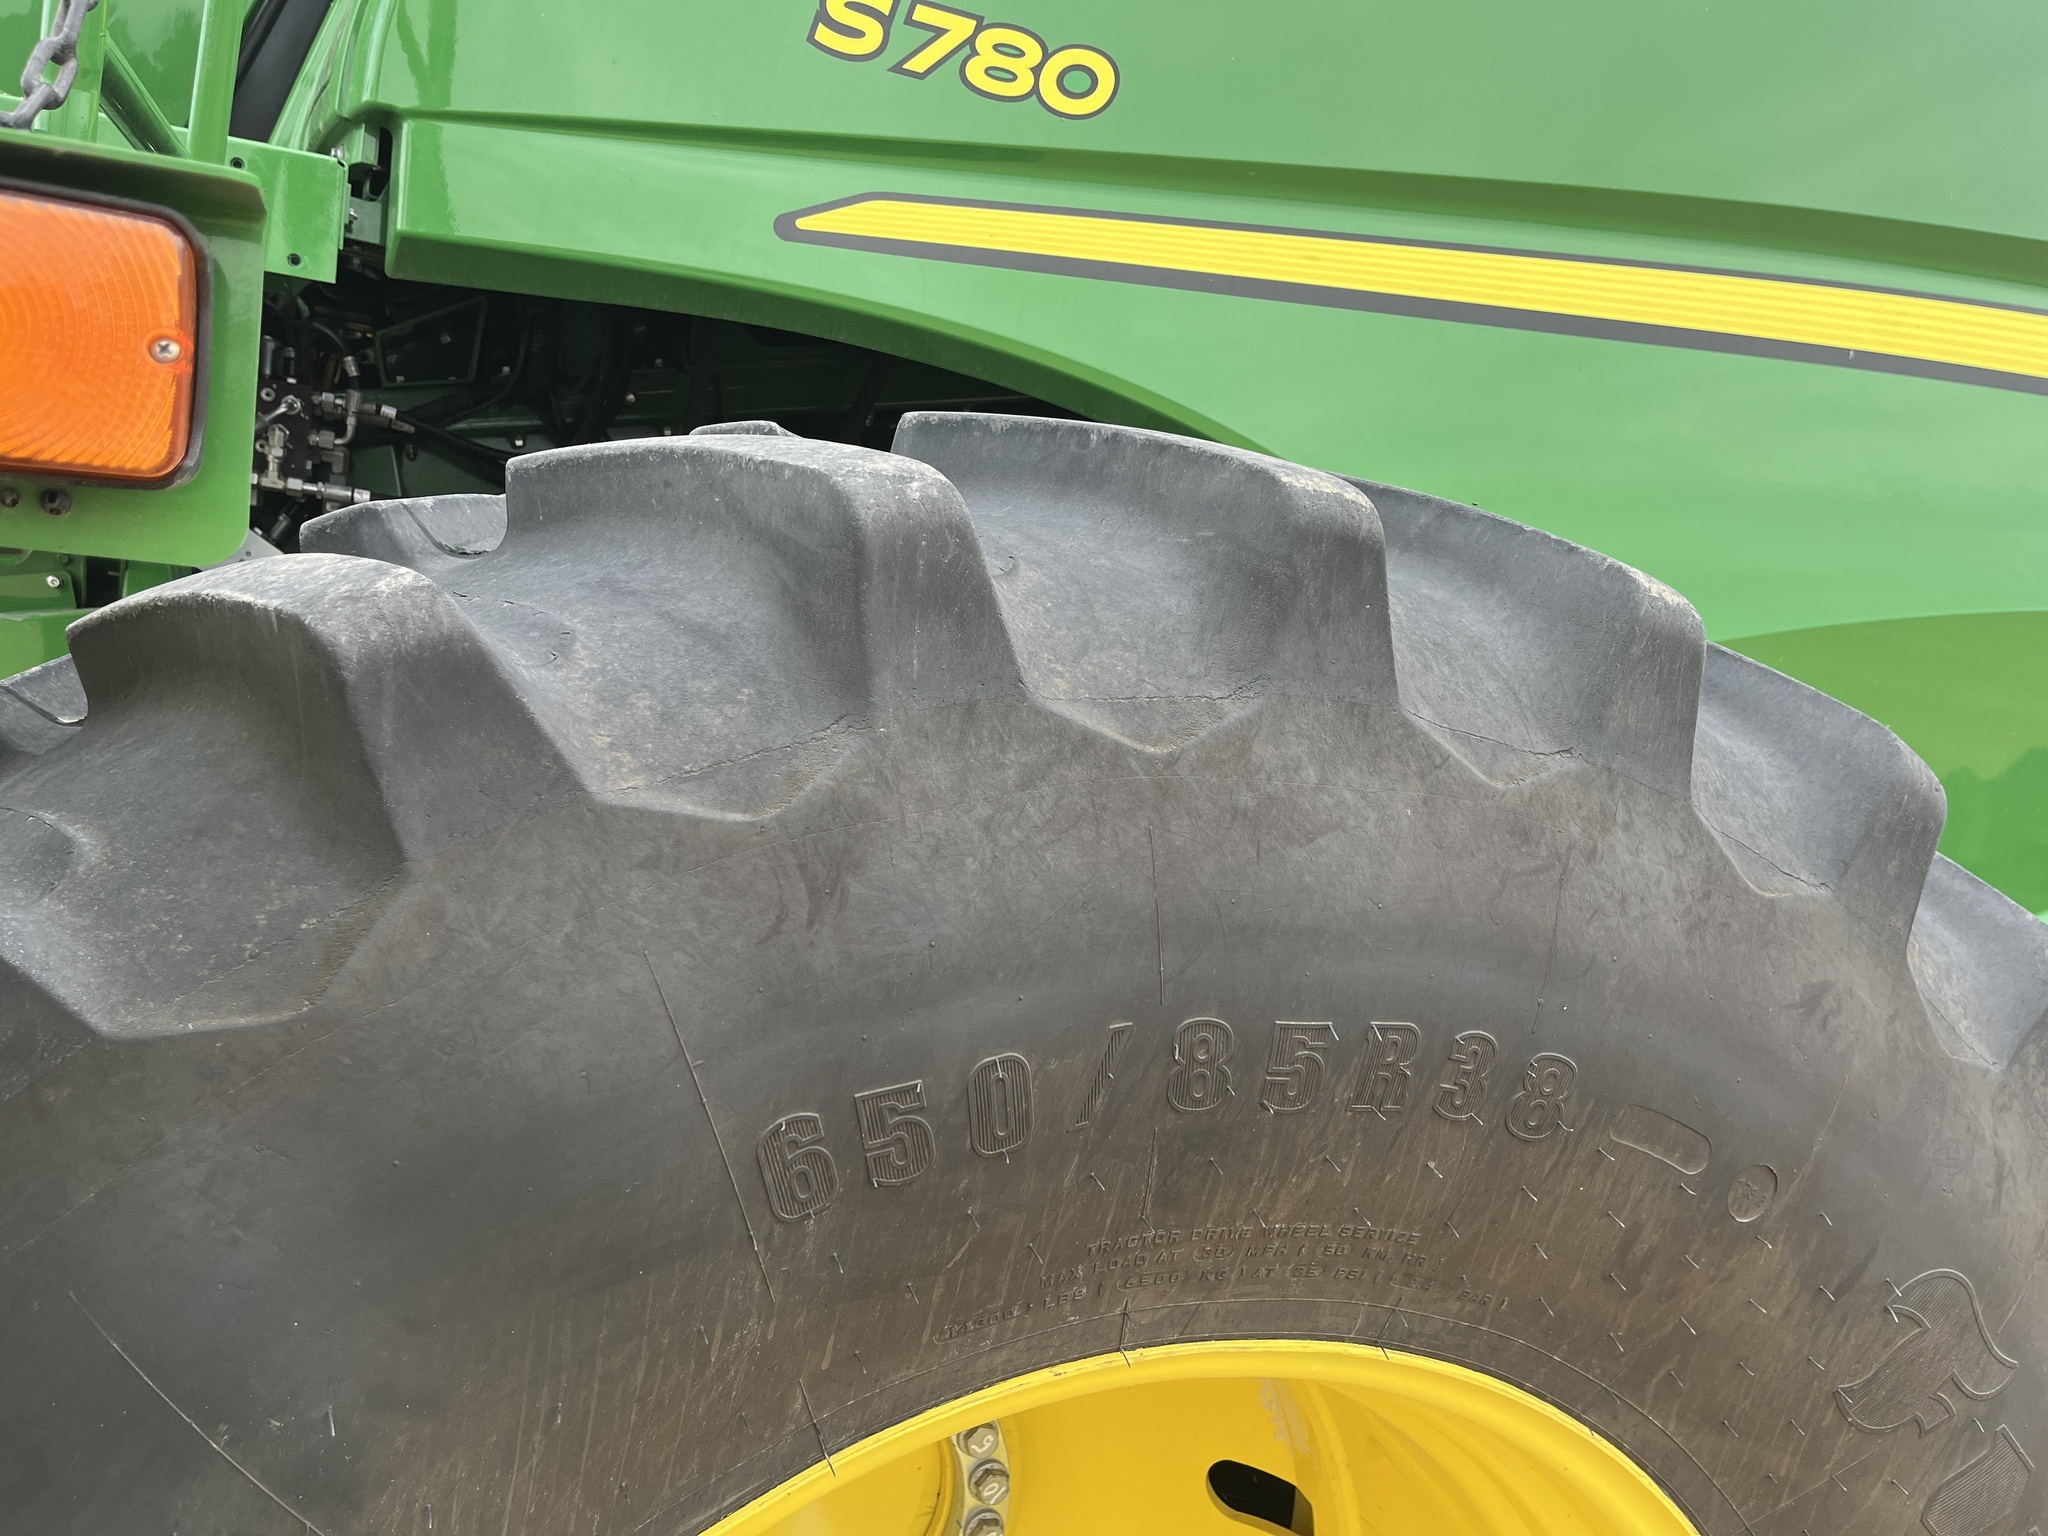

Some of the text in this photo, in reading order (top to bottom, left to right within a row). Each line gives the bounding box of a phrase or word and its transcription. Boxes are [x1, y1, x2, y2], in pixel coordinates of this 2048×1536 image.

[808, 0, 1119, 119] S780
[1085, 1222, 1421, 1257] TRACTOR DRIVE WHEEL SERVICE
[1040, 1265, 1084, 1290] MAX
[1092, 1249, 1149, 1275] LOAD
[1155, 1248, 1184, 1265] AT
[1042, 1285, 1088, 1311] LBS
[1250, 1263, 1280, 1279] AT
[1457, 1288, 1493, 1306] BAR
